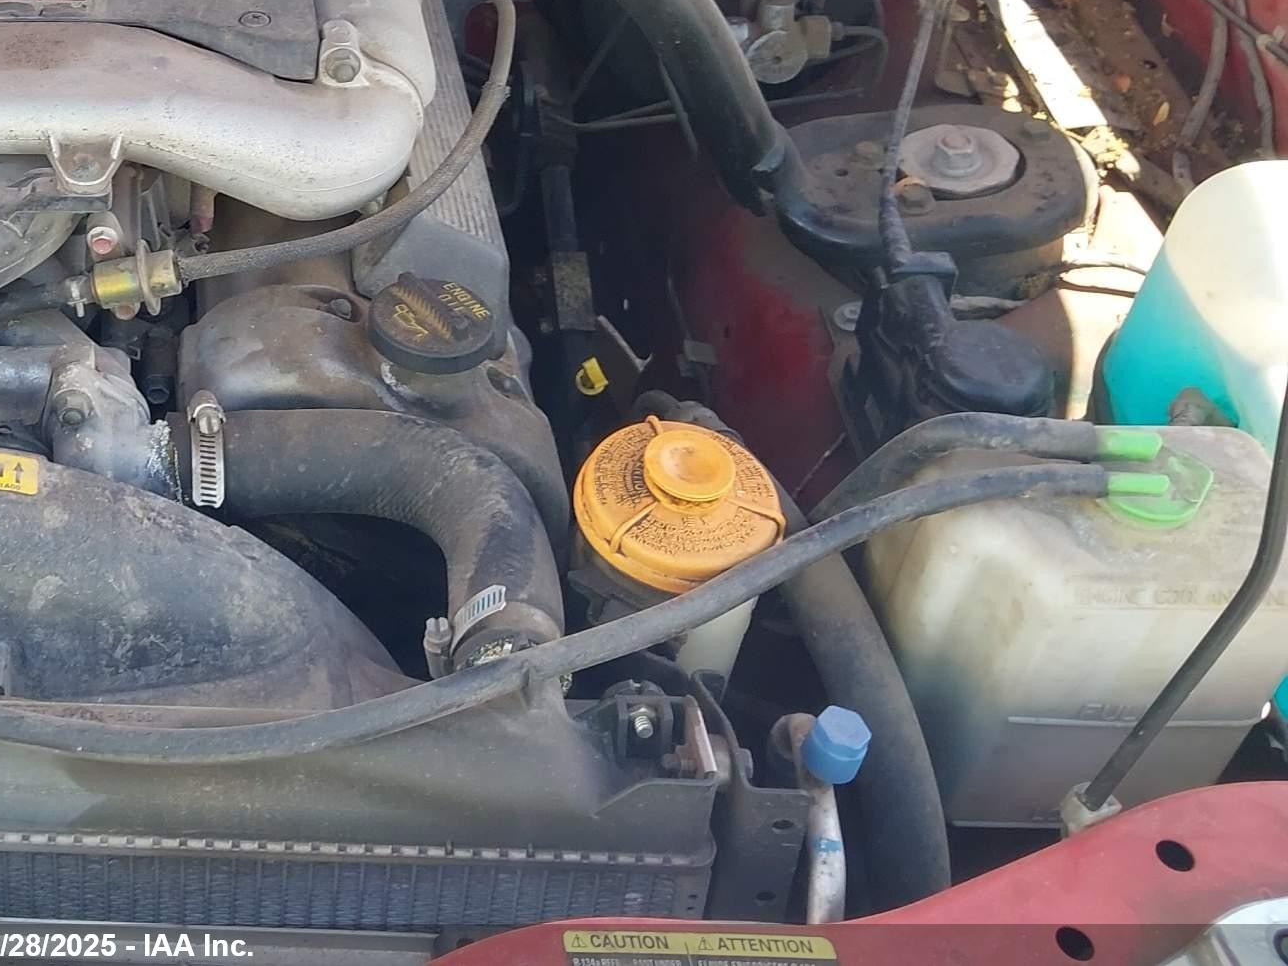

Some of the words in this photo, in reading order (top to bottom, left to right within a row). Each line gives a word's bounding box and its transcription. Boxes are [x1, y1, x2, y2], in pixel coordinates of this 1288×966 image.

[438, 294, 465, 312] OIL
[442, 282, 491, 321] ENGINE
[590, 934, 669, 949] CAUTION
[717, 936, 814, 954] ATTENTION
